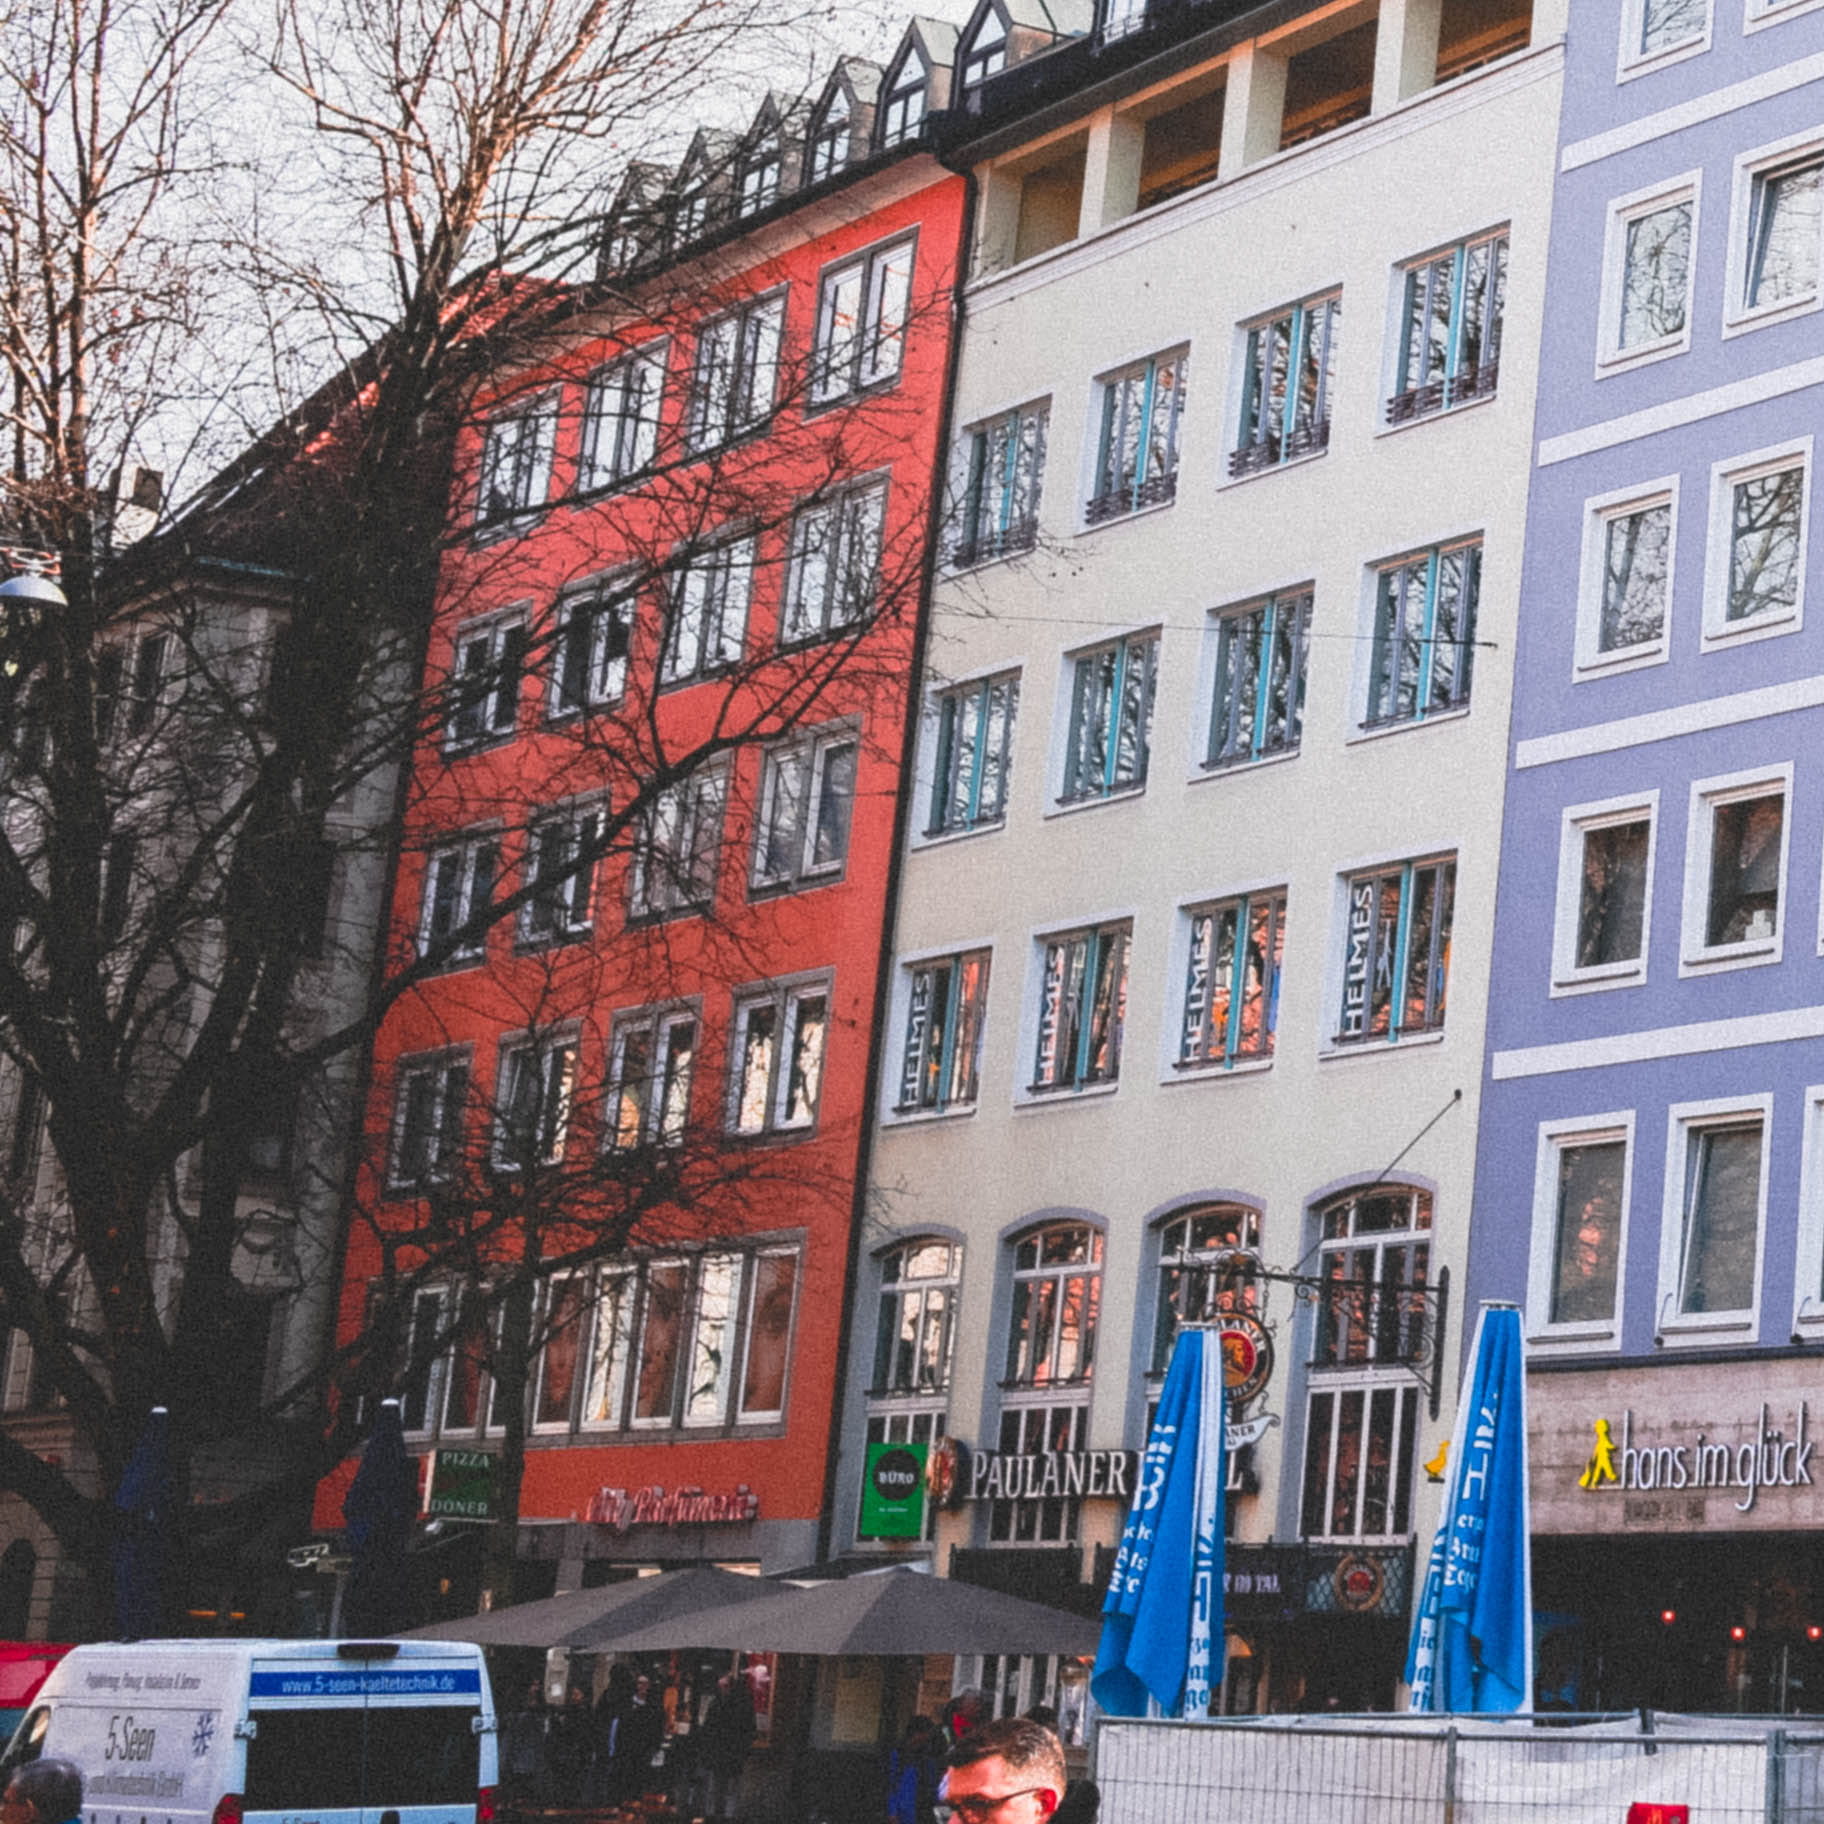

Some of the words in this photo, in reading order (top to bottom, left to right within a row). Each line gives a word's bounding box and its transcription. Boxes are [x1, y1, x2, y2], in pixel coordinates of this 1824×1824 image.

[441, 1451, 490, 1469] PIZZA
[966, 1450, 1126, 1500] PAULANER
[1621, 1409, 1689, 1489] hans
[1694, 1433, 1729, 1486] im
[1735, 1401, 1813, 1510] glück
[105, 1715, 156, 1762] 5-Seen
